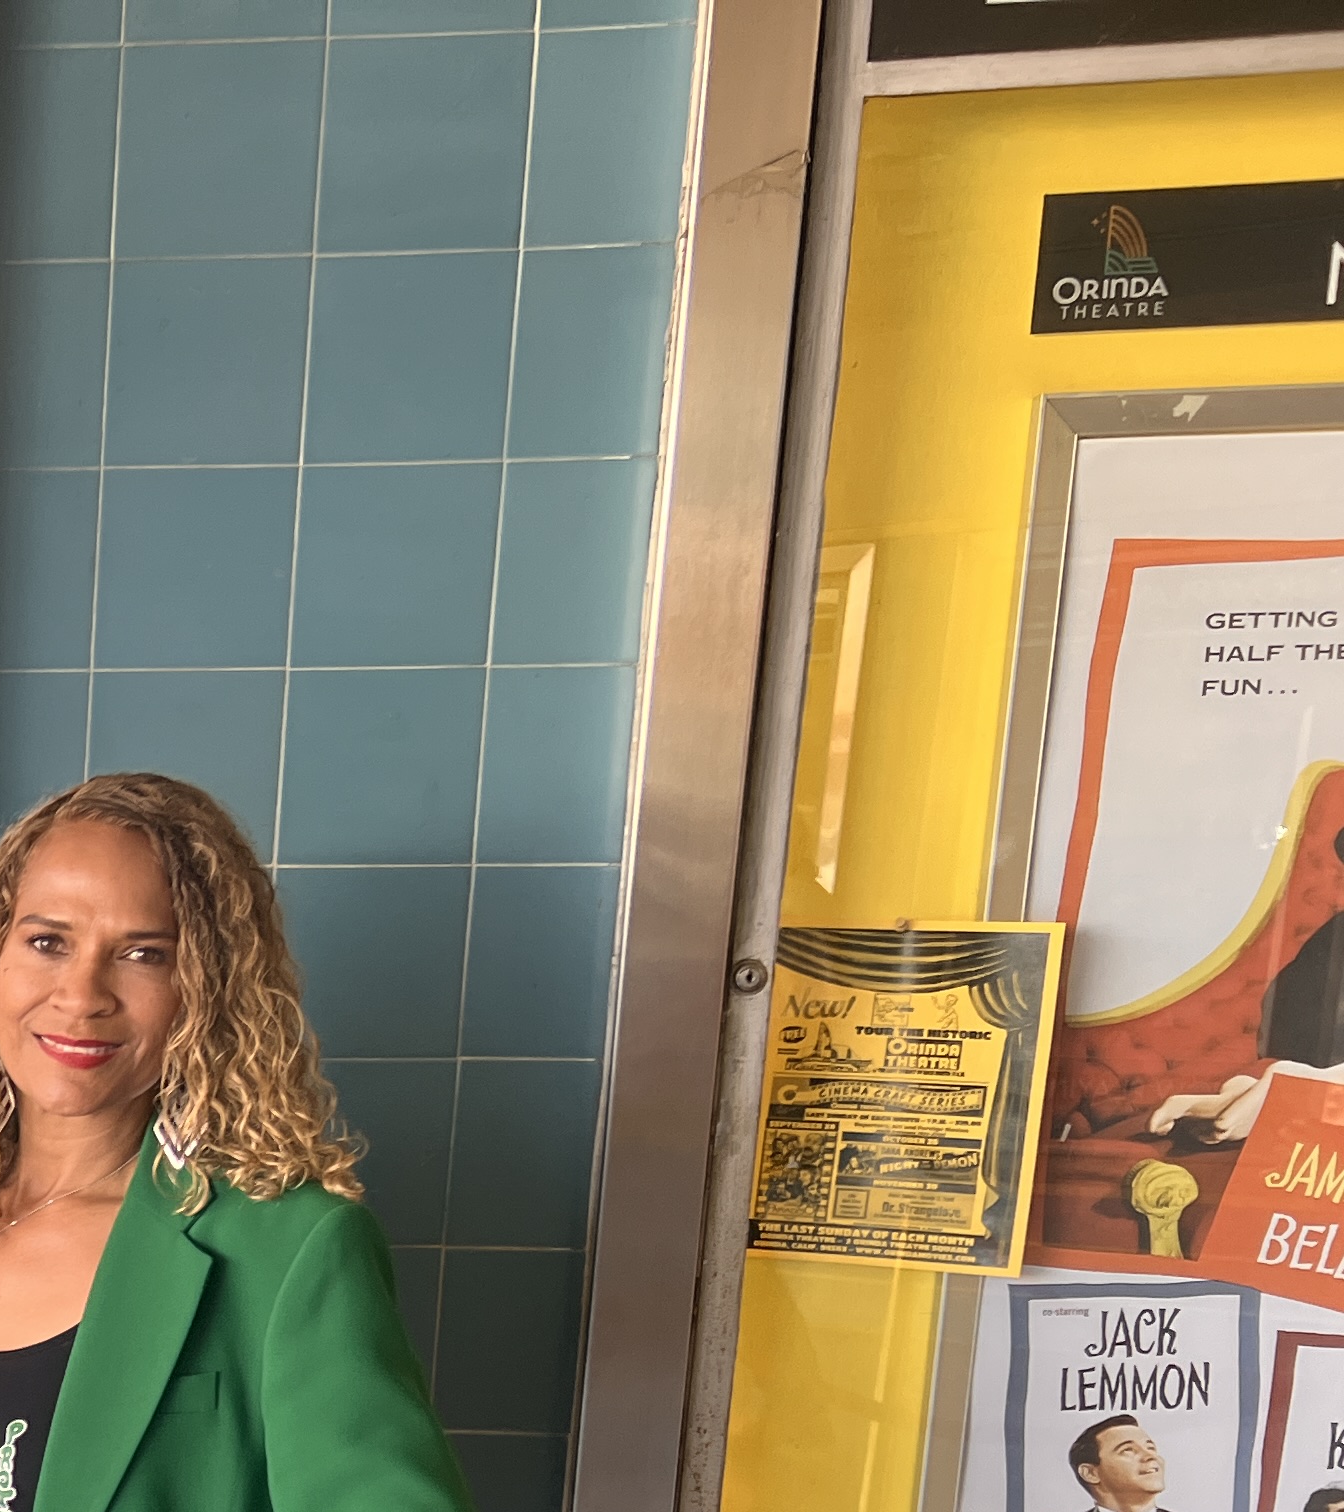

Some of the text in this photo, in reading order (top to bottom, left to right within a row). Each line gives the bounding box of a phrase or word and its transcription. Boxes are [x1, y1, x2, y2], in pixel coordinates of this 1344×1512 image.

[1053, 276, 1169, 305] ORINDA
[1061, 302, 1164, 320] THEATRE
[1205, 610, 1339, 630] GETTING
[1204, 643, 1285, 663] HALF
[1201, 677, 1300, 697] FUN...
[781, 989, 857, 1020] New!
[855, 1025, 894, 1037] TOUR
[927, 1028, 992, 1041] HISTORIC
[886, 1055, 960, 1071] THEATRE
[818, 1084, 967, 1107] CINEMA CRAFT SERIES
[1256, 1212, 1344, 1280] BEL
[1084, 1307, 1181, 1358] JACK
[1060, 1361, 1211, 1412] LEMMON
